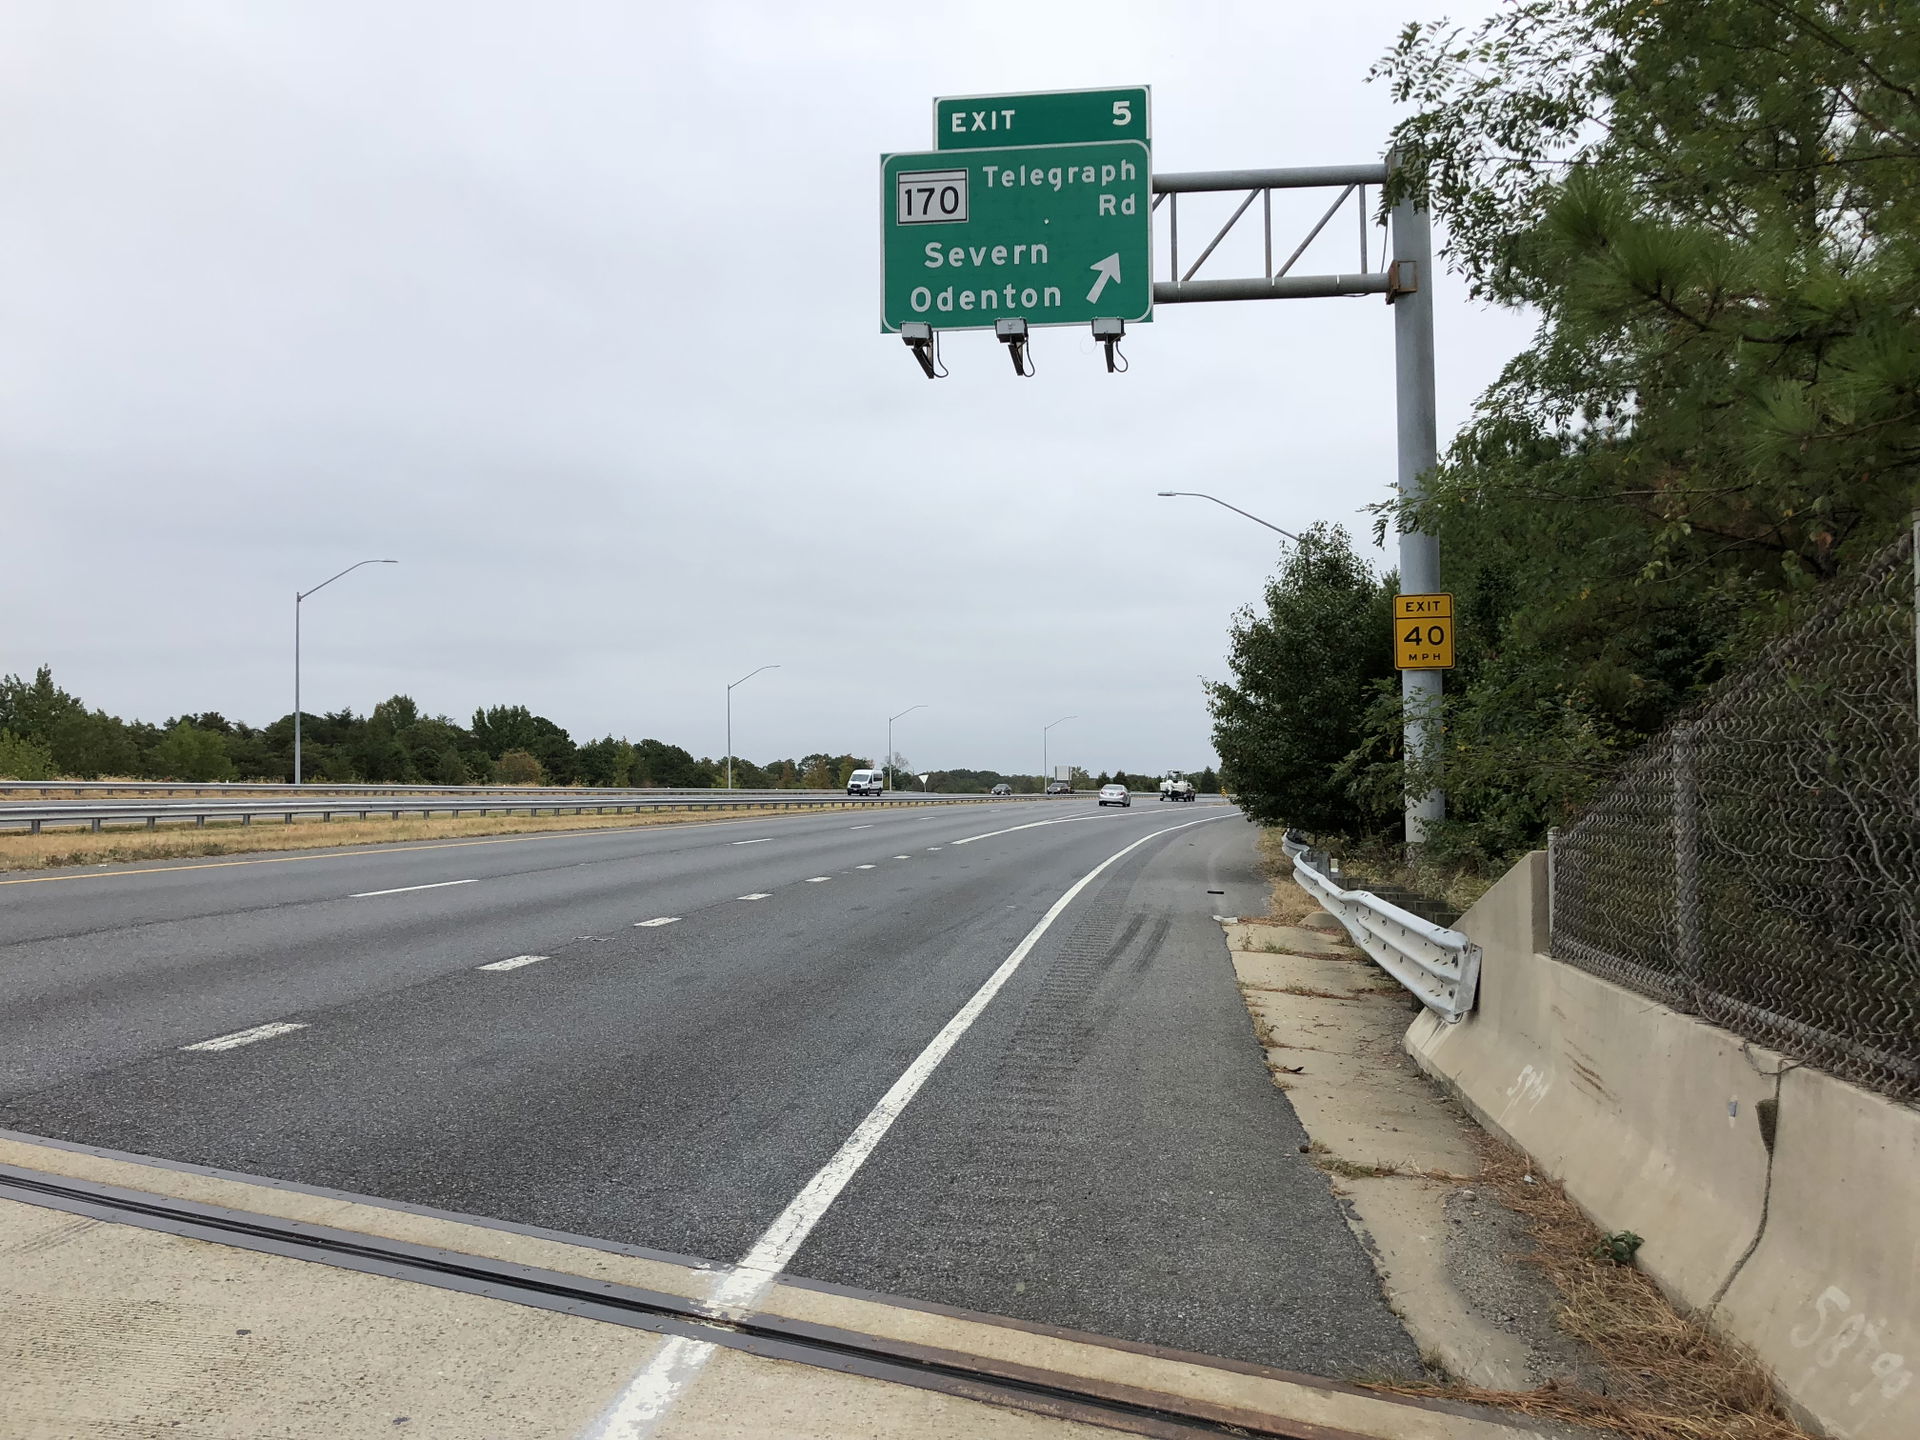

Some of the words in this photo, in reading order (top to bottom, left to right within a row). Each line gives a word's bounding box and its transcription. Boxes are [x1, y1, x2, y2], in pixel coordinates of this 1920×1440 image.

[951, 109, 1016, 133] EXIT
[1112, 100, 1132, 126] 5
[982, 159, 1136, 192] Telegraph
[904, 185, 960, 217] 170
[1099, 194, 1136, 217] Rd
[924, 241, 1048, 268] Severn
[910, 282, 1062, 313] Odenton
[1405, 600, 1441, 612] EXIT
[1403, 625, 1445, 646] 40
[1408, 653, 1441, 661] MPH
